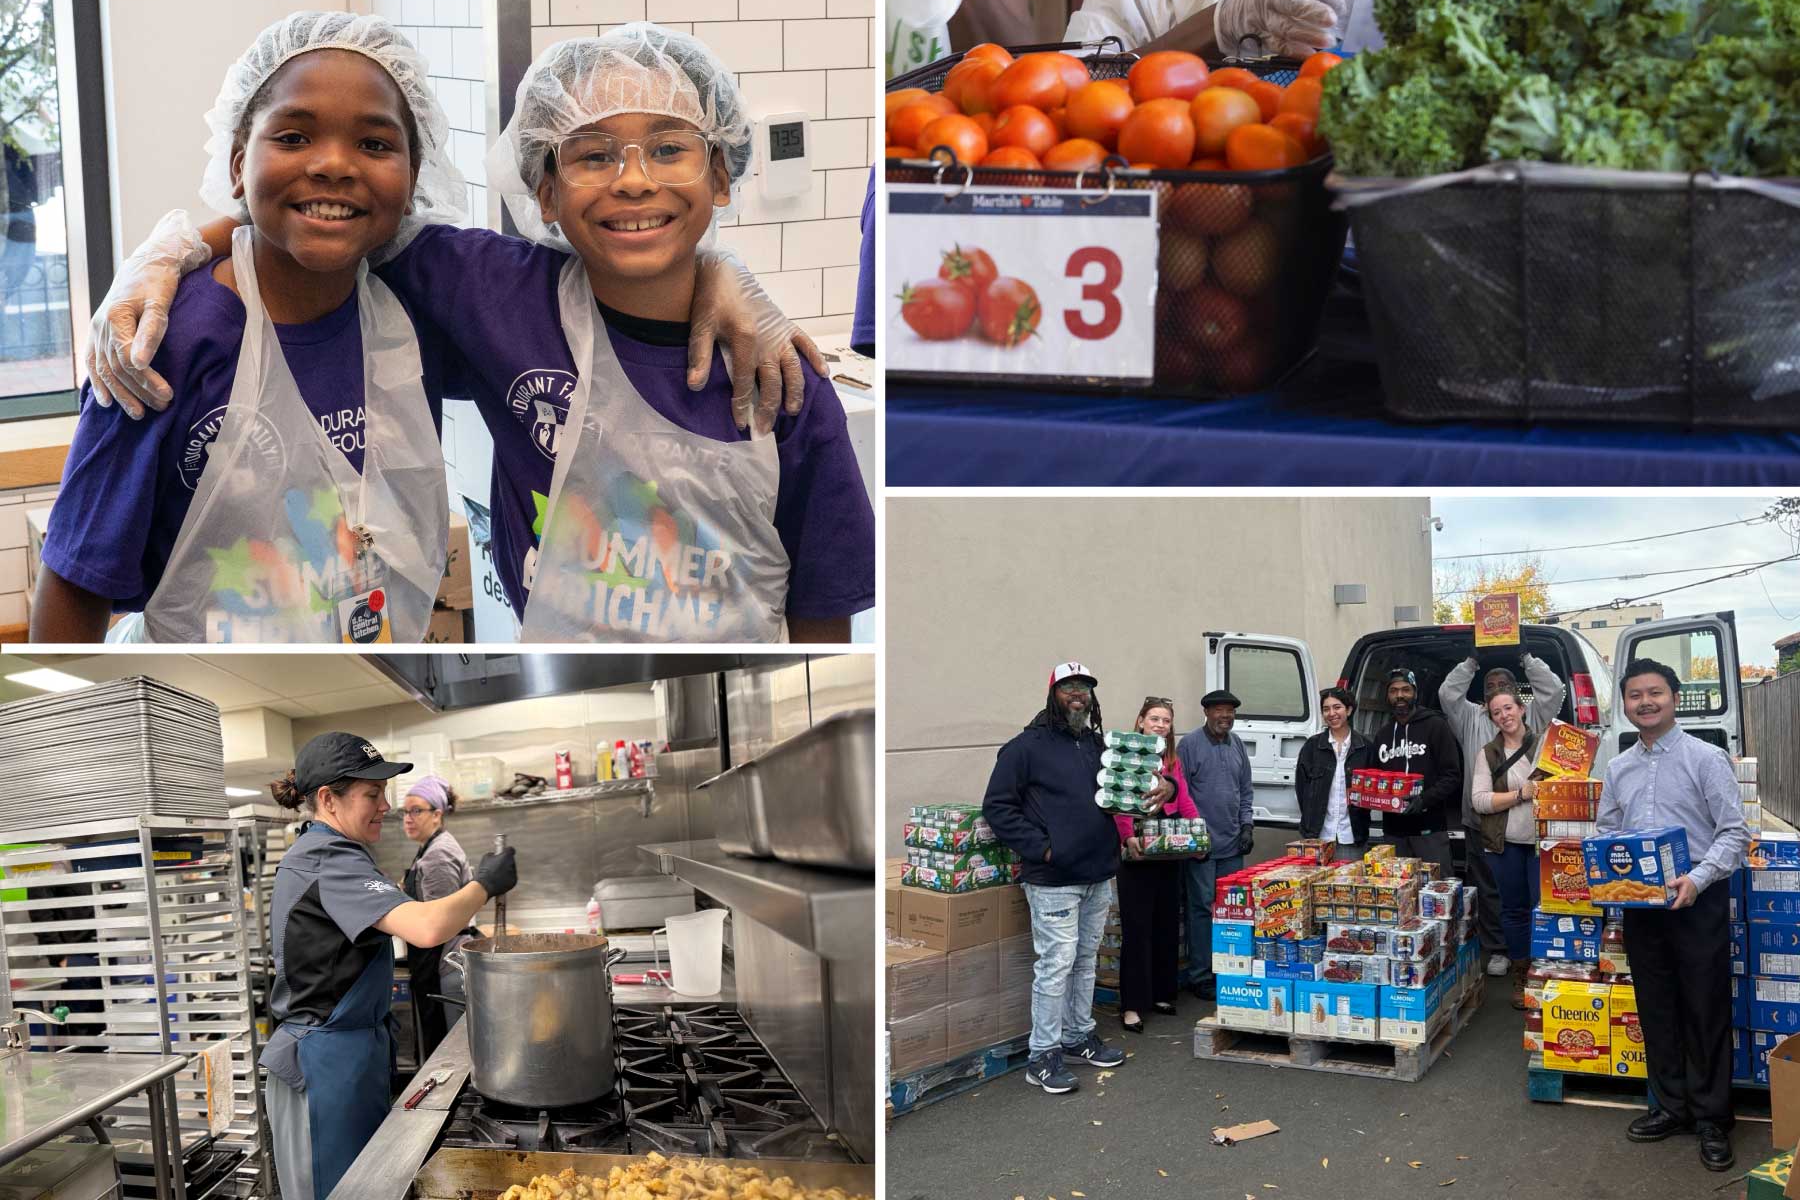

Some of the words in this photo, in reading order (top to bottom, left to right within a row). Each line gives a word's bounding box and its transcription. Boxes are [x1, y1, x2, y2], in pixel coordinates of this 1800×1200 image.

[1063, 246, 1123, 341] 3
[1552, 852, 1586, 864] Cheerio
[1264, 881, 1287, 894] SPAM
[1224, 892, 1244, 906] Jif
[1266, 901, 1290, 914] SPAM
[1220, 985, 1263, 998] ALMOND
[1551, 1005, 1600, 1022] Cheerios
